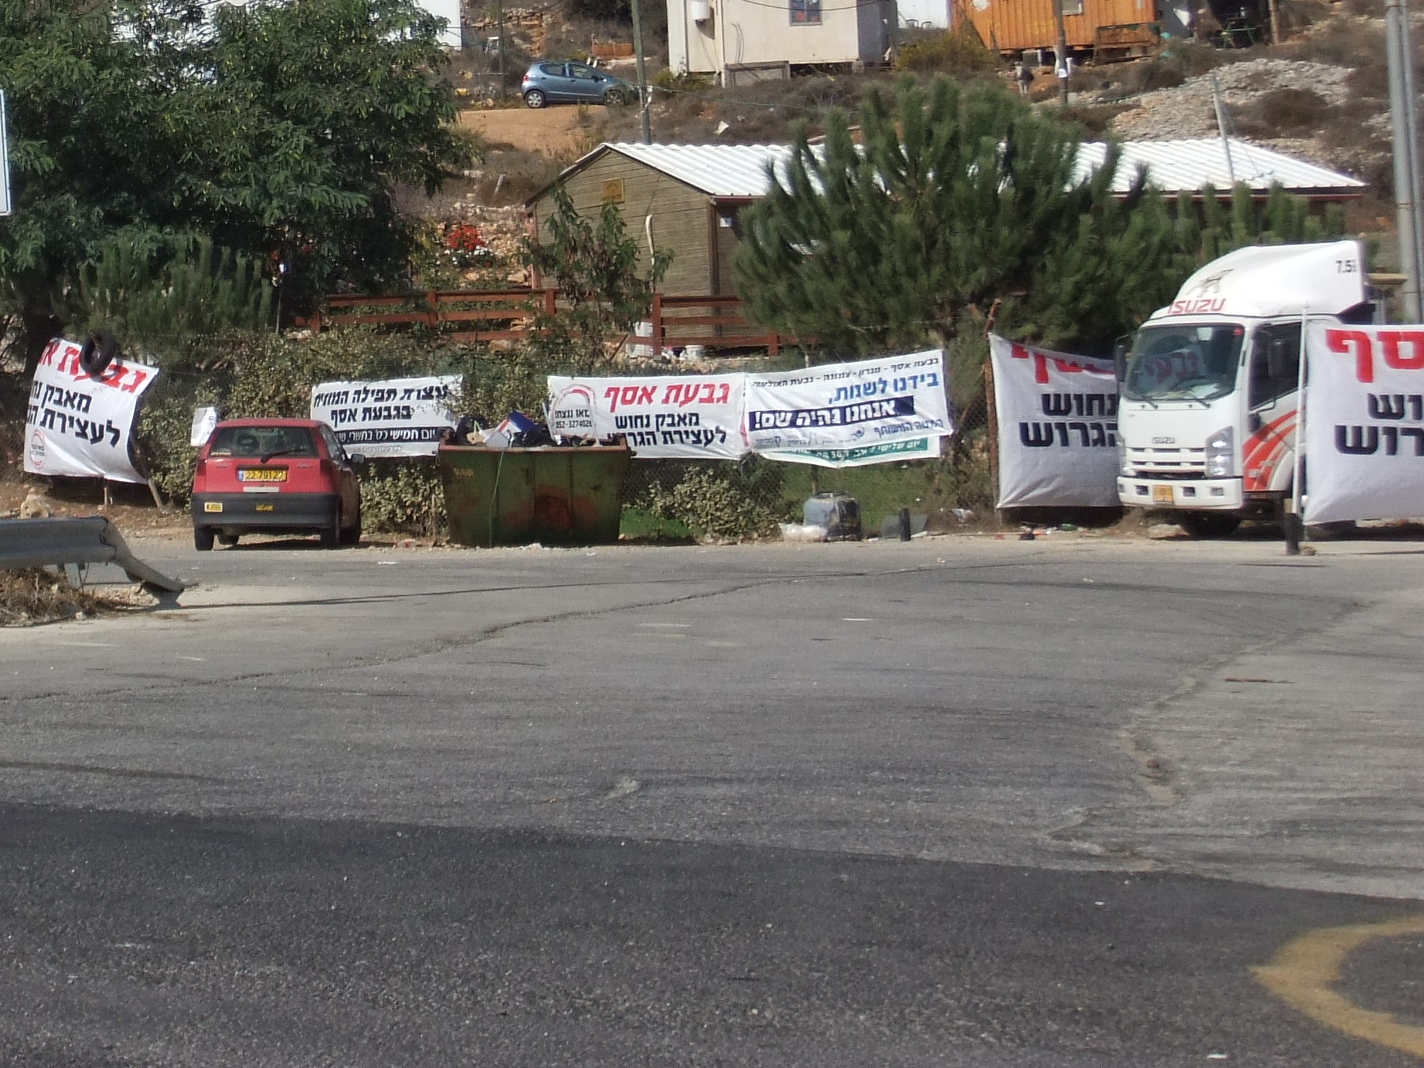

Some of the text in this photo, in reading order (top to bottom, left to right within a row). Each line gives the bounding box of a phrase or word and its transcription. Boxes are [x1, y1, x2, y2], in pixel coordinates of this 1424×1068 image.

[1167, 298, 1226, 315] ISUZU
[890, 362, 912, 373] אסף
[1325, 328, 1424, 383] סף
[57, 346, 147, 394] גבת
[41, 384, 93, 414] מאבק
[352, 386, 398, 406] תפילה
[604, 383, 731, 413] גבעת אסף
[828, 372, 939, 404] בידנו לשנות,
[330, 407, 358, 428] אסף
[754, 399, 896, 429] אנחנו נהיה שם!
[1040, 393, 1118, 417] נחוש
[1367, 393, 1423, 420] וש
[39, 408, 121, 448] לעצירת
[614, 412, 699, 432] מאבק נחוש
[390, 430, 418, 440] חמישי
[421, 430, 436, 440] יום
[662, 425, 727, 448] לעצירת
[1019, 422, 1119, 448] הגרוש
[1151, 436, 1176, 445] ISUZU
[1334, 424, 1424, 457] רוש
